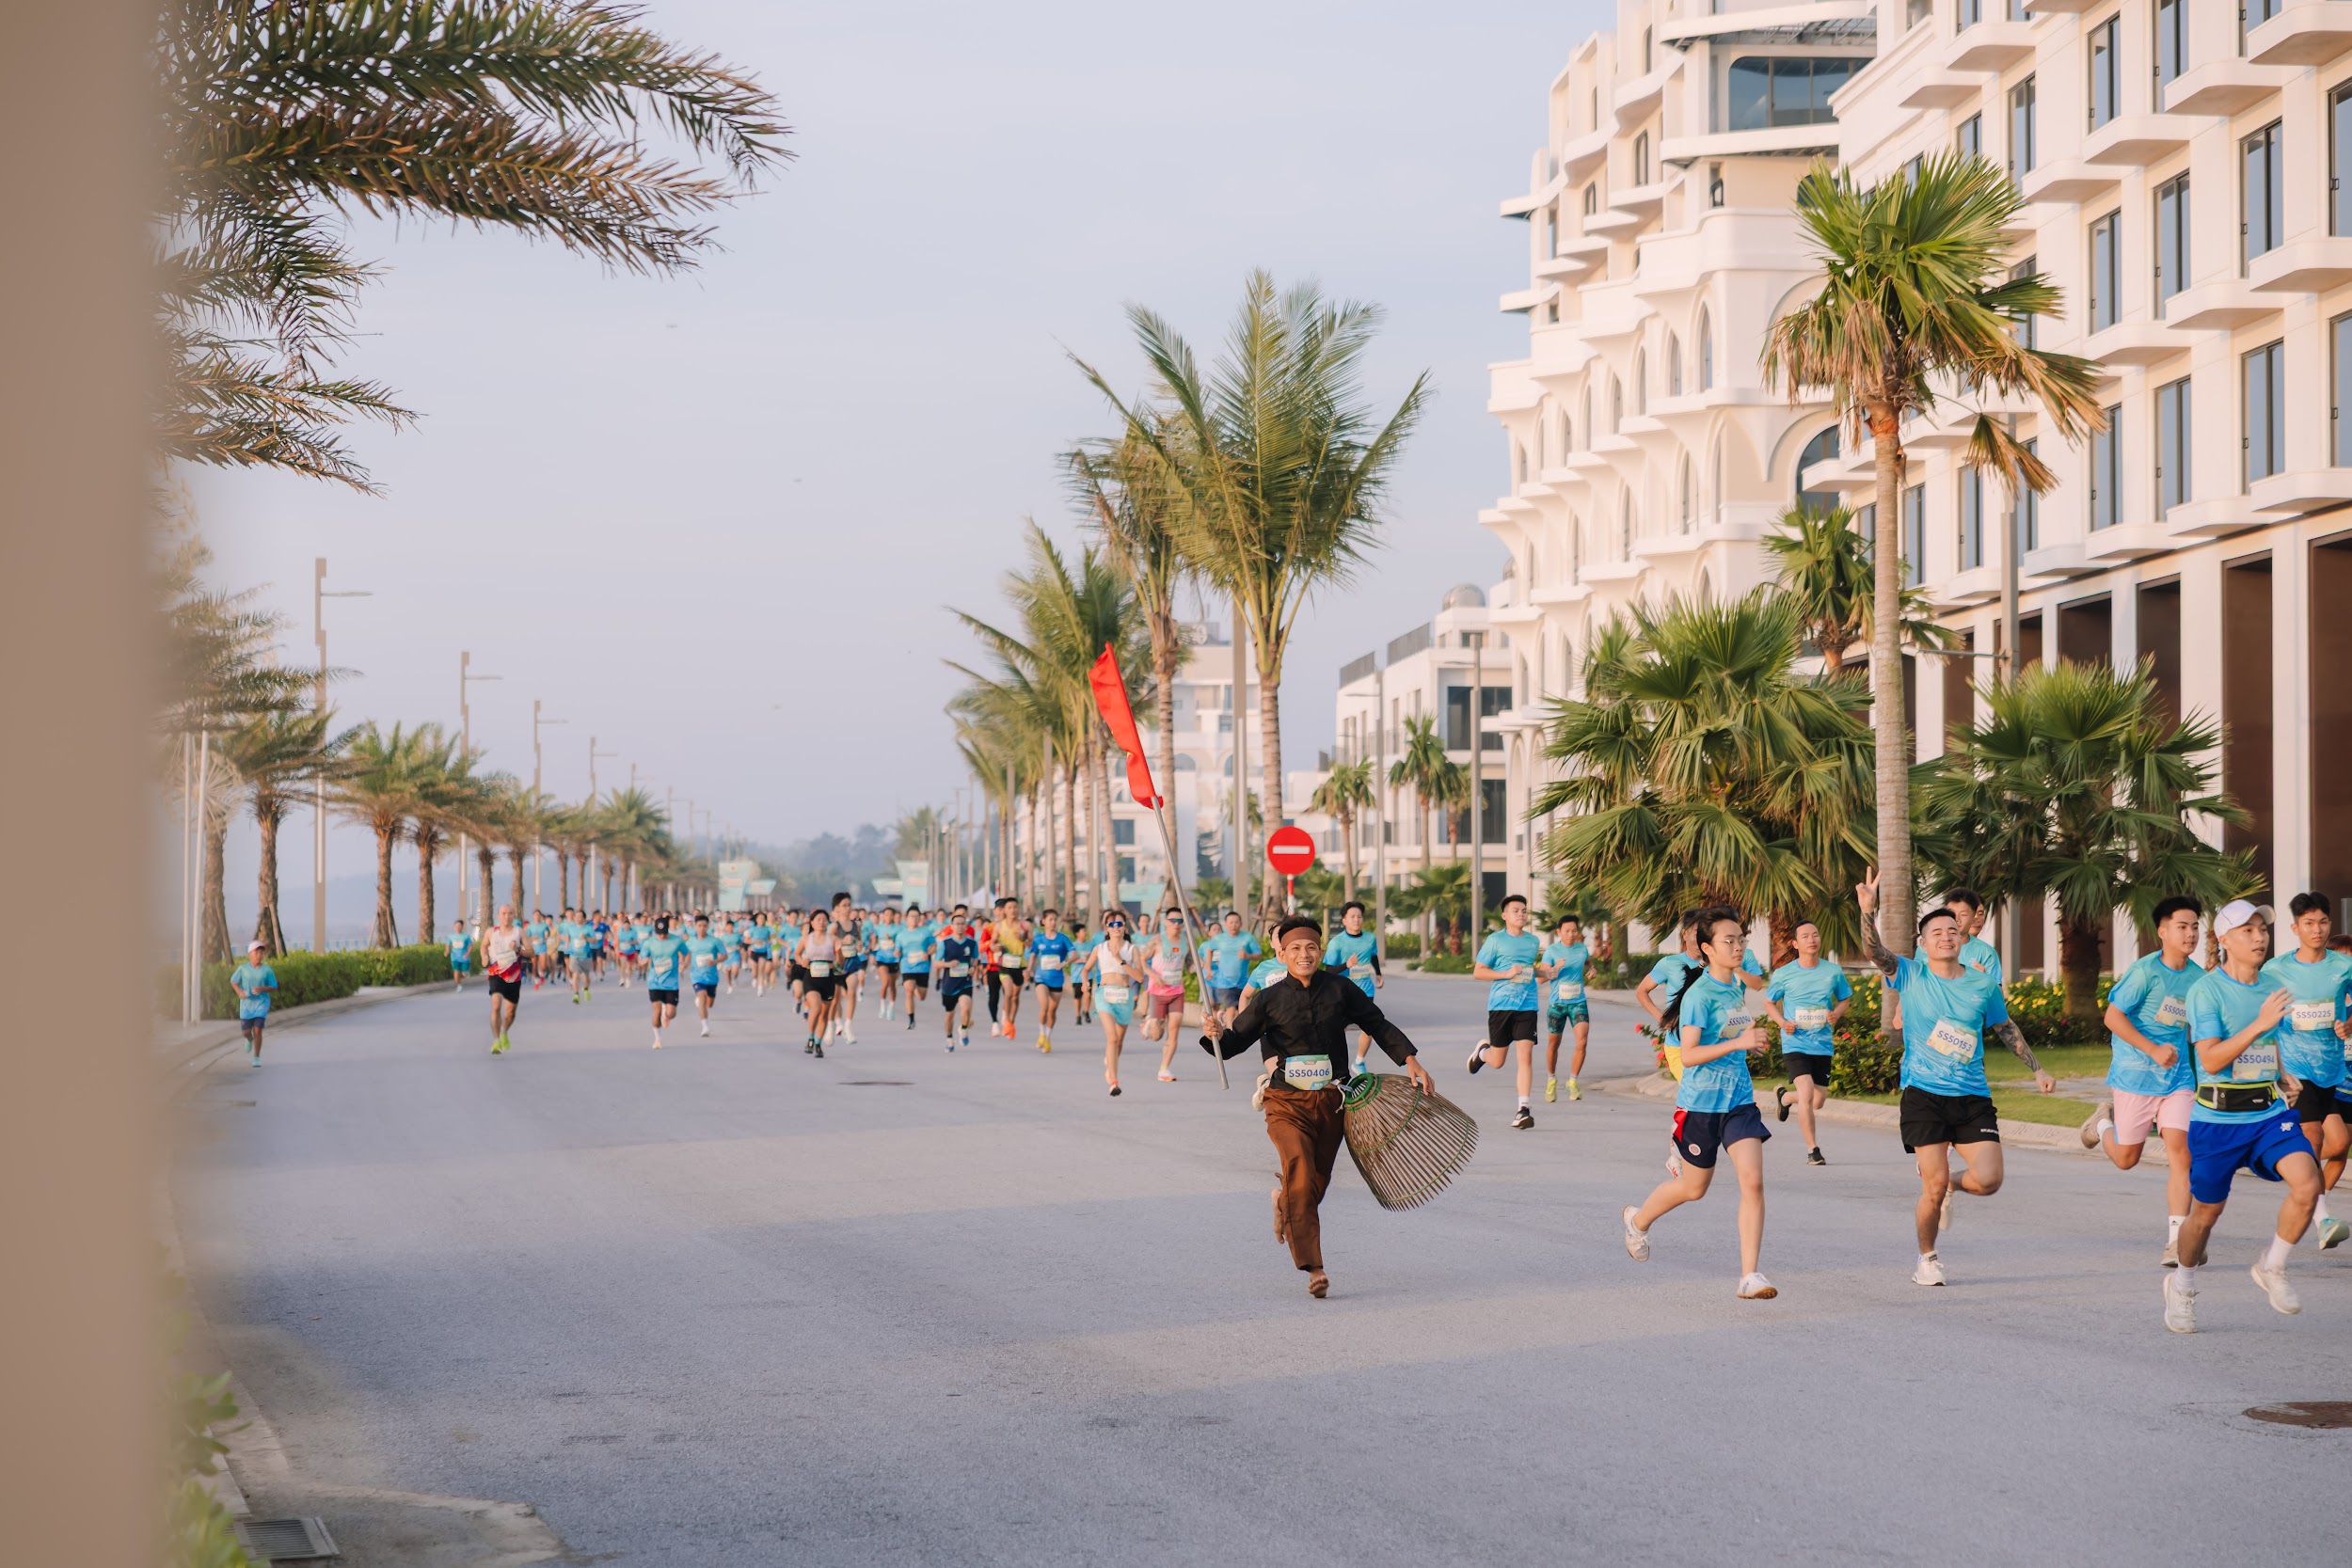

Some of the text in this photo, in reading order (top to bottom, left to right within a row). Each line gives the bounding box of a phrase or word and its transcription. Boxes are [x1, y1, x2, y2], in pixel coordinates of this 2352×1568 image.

[2163, 1004, 2186, 1018] SS5005
[2296, 1010, 2331, 1019] SS50225
[1937, 1030, 1973, 1052] SS50153
[2237, 1054, 2275, 1064] SS50494
[1289, 1068, 1330, 1078] SS50406
